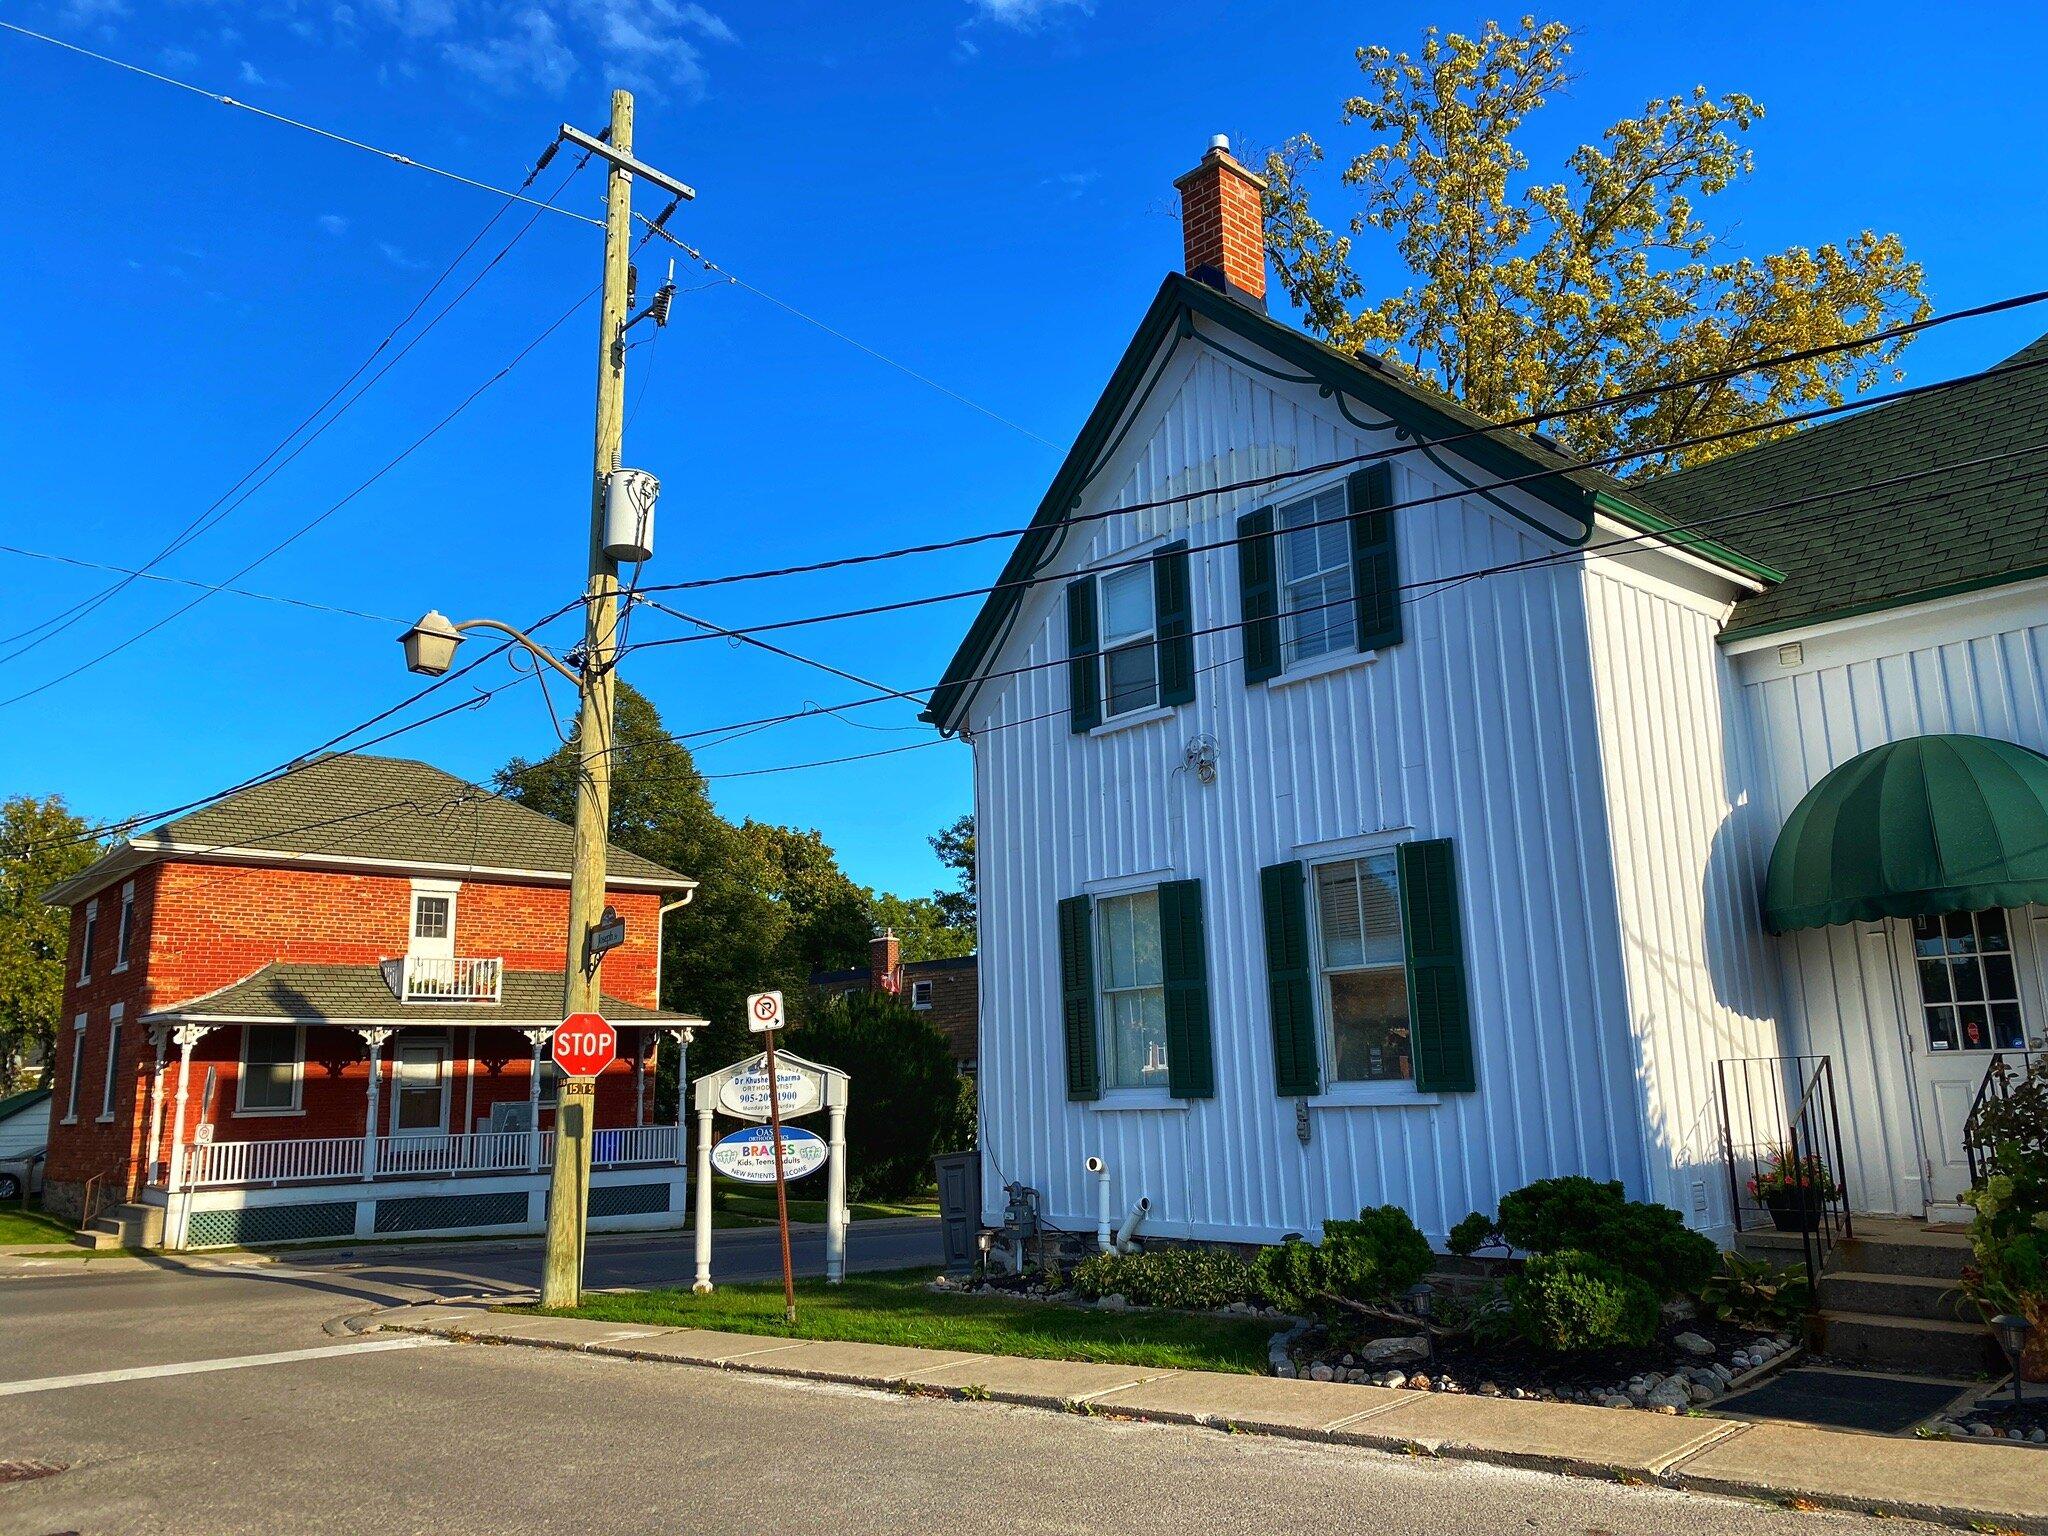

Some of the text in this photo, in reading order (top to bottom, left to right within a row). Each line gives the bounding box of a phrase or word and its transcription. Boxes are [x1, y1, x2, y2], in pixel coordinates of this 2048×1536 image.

[557, 1032, 612, 1057] STOP
[734, 1074, 801, 1085] Dr Khushe Sharma
[742, 1083, 793, 1092] ORTHODNTIST
[739, 1091, 797, 1103] 905-2091900
[742, 1143, 795, 1156] BRACES
[737, 1158, 753, 1167] Kids,
[781, 1156, 801, 1164] dults
[731, 1168, 747, 1177] NEW
